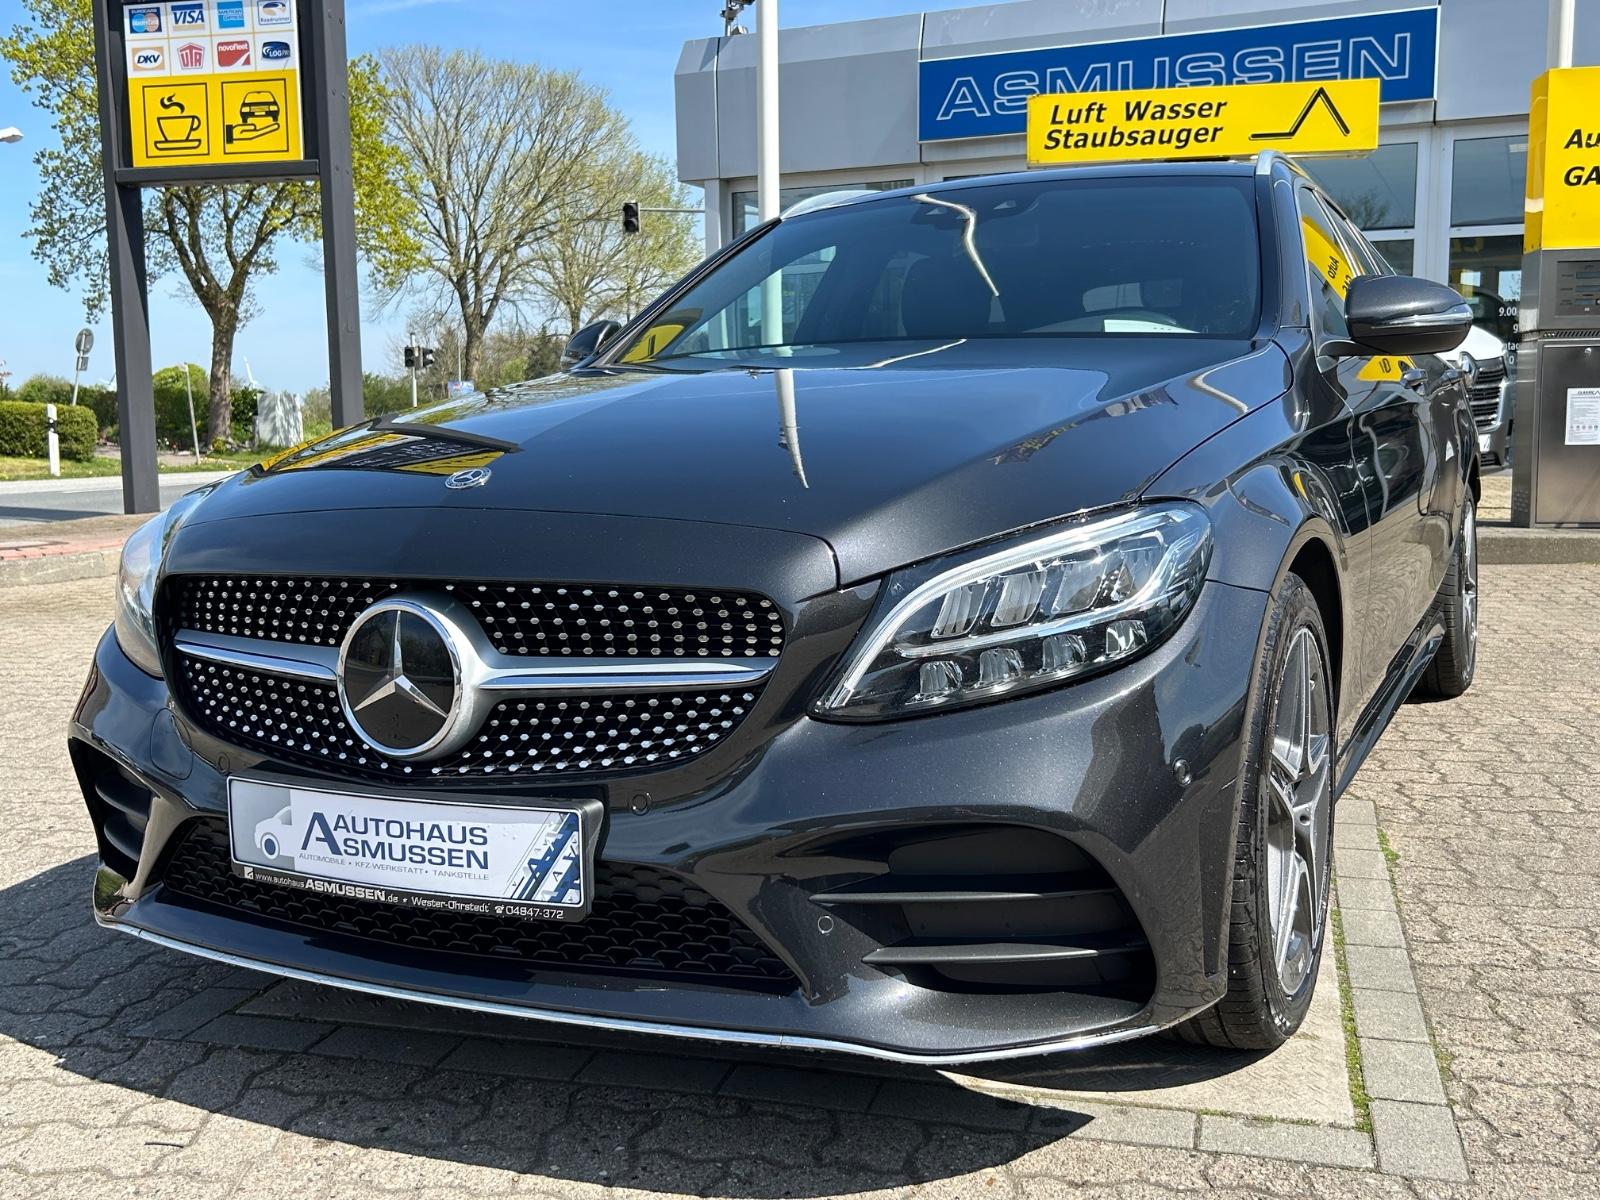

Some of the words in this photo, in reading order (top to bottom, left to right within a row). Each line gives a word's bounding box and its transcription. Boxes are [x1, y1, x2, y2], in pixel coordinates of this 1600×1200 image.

[172, 10, 205, 24] VISA
[137, 54, 161, 64] DKV
[179, 45, 204, 68] UTA
[936, 33, 1411, 121] ASMUSSEN
[1050, 101, 1107, 126] Luft
[1124, 100, 1227, 122] Wasser
[1043, 125, 1224, 150] Staubsauger
[1498, 306, 1518, 317] 9.00
[333, 813, 488, 846] AUTOHAUS
[299, 852, 345, 866] AUTOMOBILE
[433, 868, 489, 881] TANKSTELLE
[505, 905, 564, 920] 04847-372
